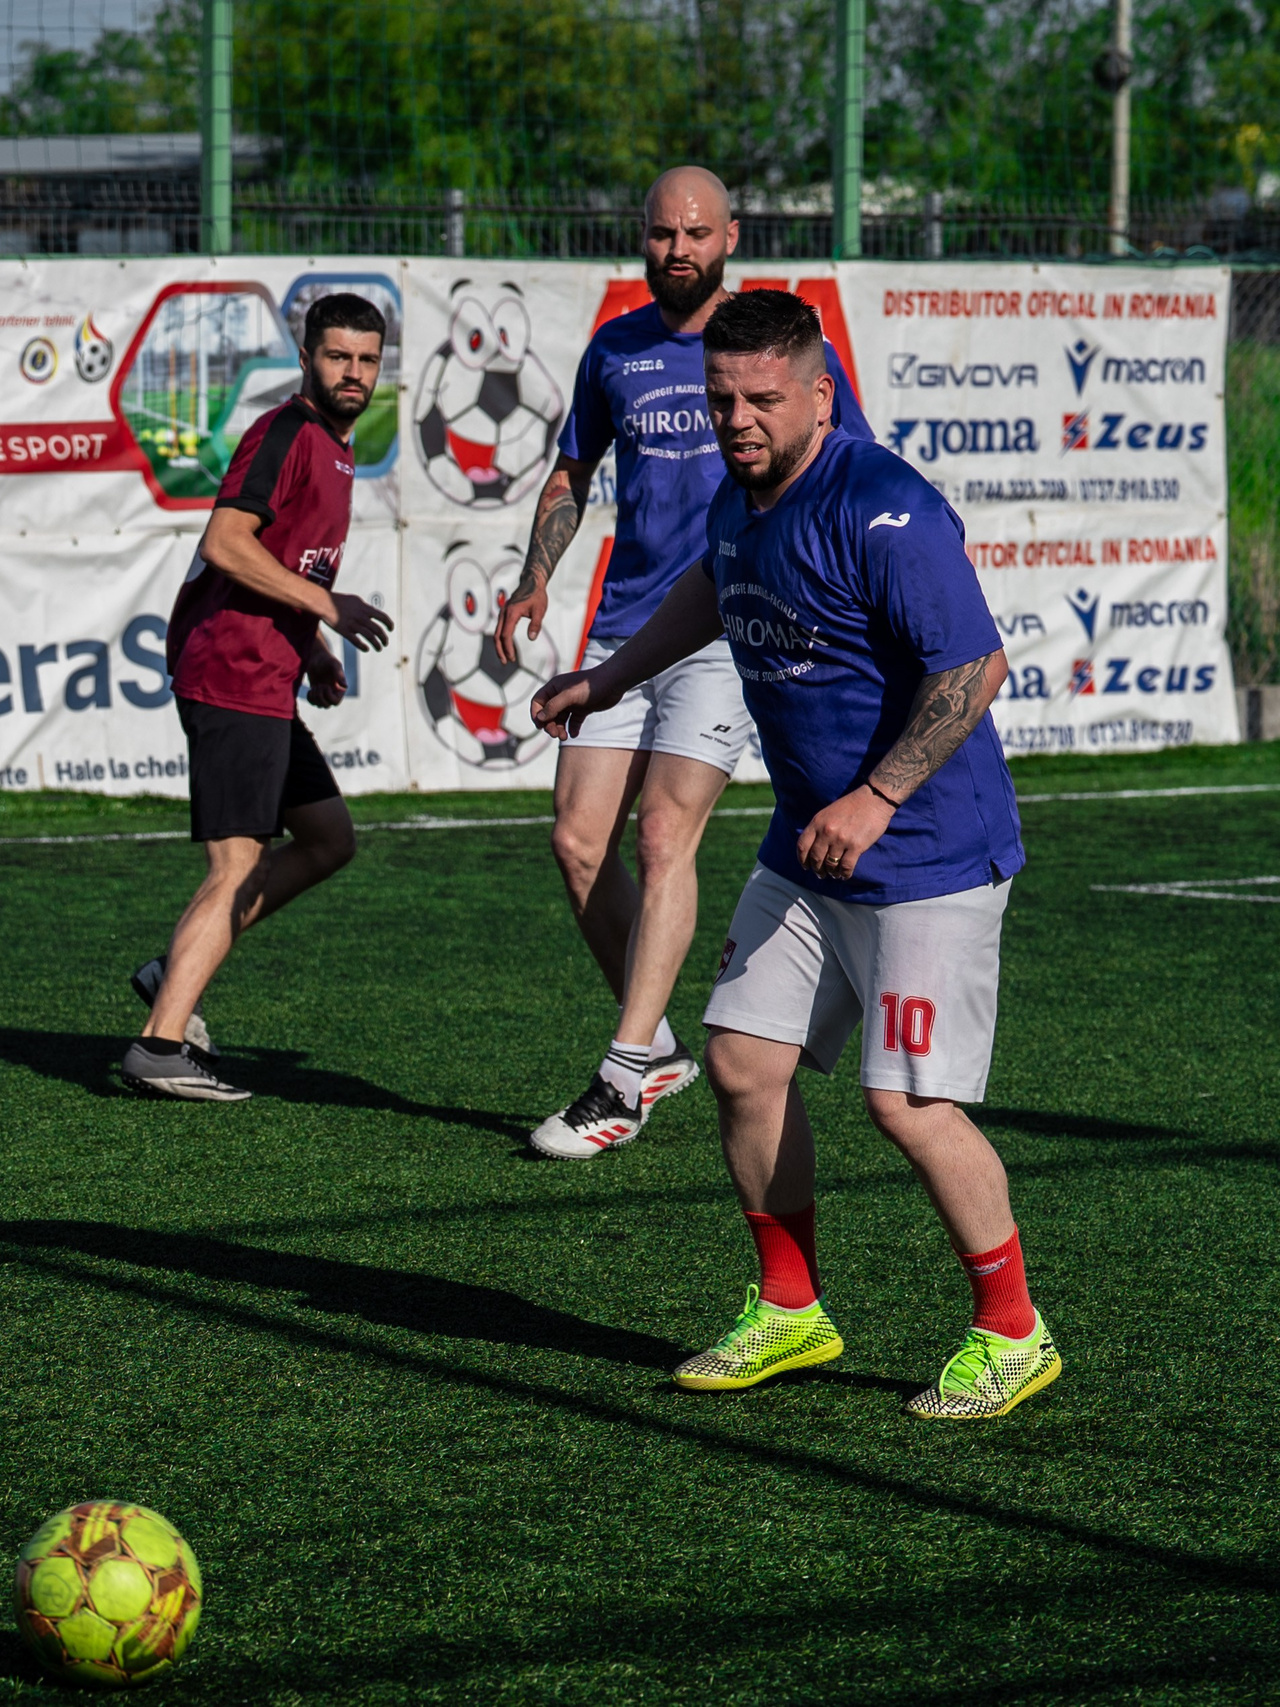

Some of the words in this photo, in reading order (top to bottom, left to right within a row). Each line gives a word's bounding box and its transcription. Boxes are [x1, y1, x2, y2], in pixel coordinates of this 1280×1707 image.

[883, 290, 1021, 317] DISTRIBUITOR
[1027, 291, 1096, 317] OFICIAL
[1102, 293, 1125, 318] IN
[1128, 293, 1217, 318] ROMANIA
[622, 358, 665, 375] Joma
[916, 363, 1038, 388] GIVOVA
[1102, 356, 1206, 384] macron
[633, 386, 674, 409] CHIRURGIE
[674, 384, 706, 395] MAXILO
[1093, 412, 1208, 450] Zeus
[8, 433, 108, 461] SPORT
[1022, 539, 1096, 567] OFICIAL
[1101, 538, 1123, 565] IN
[1127, 536, 1218, 564] ROMANIA
[1110, 600, 1208, 628] macron
[1103, 658, 1216, 694] Zeus
[55, 758, 106, 782] Hale
[108, 756, 131, 780] la
[135, 753, 189, 777] chei
[879, 991, 936, 1058] 10
